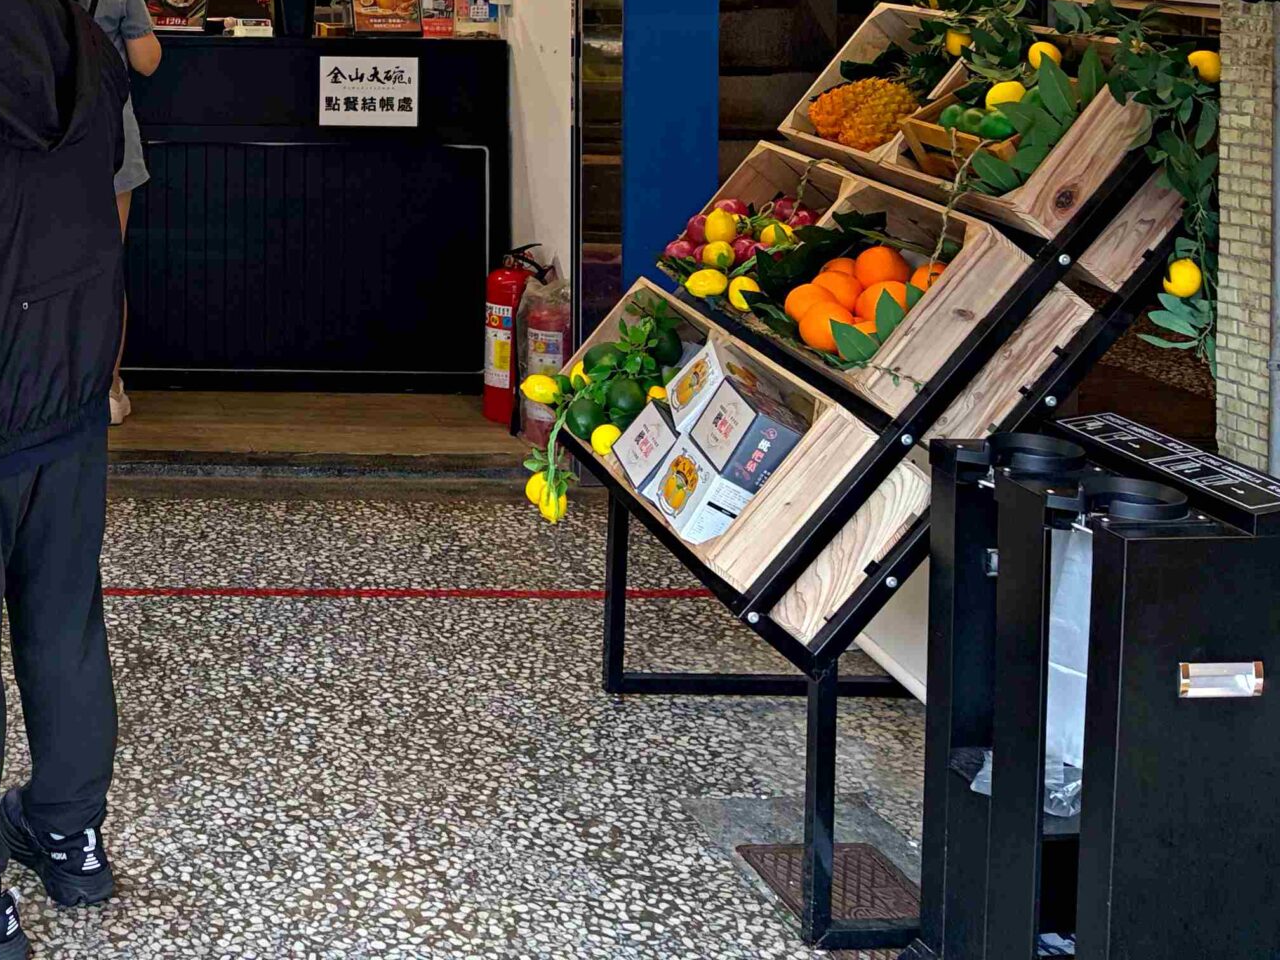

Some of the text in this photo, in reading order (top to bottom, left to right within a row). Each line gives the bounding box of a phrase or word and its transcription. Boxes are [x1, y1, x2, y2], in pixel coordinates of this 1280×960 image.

[327, 66, 407, 85] 金山大碗
[324, 96, 413, 112] 點餐結帳處
